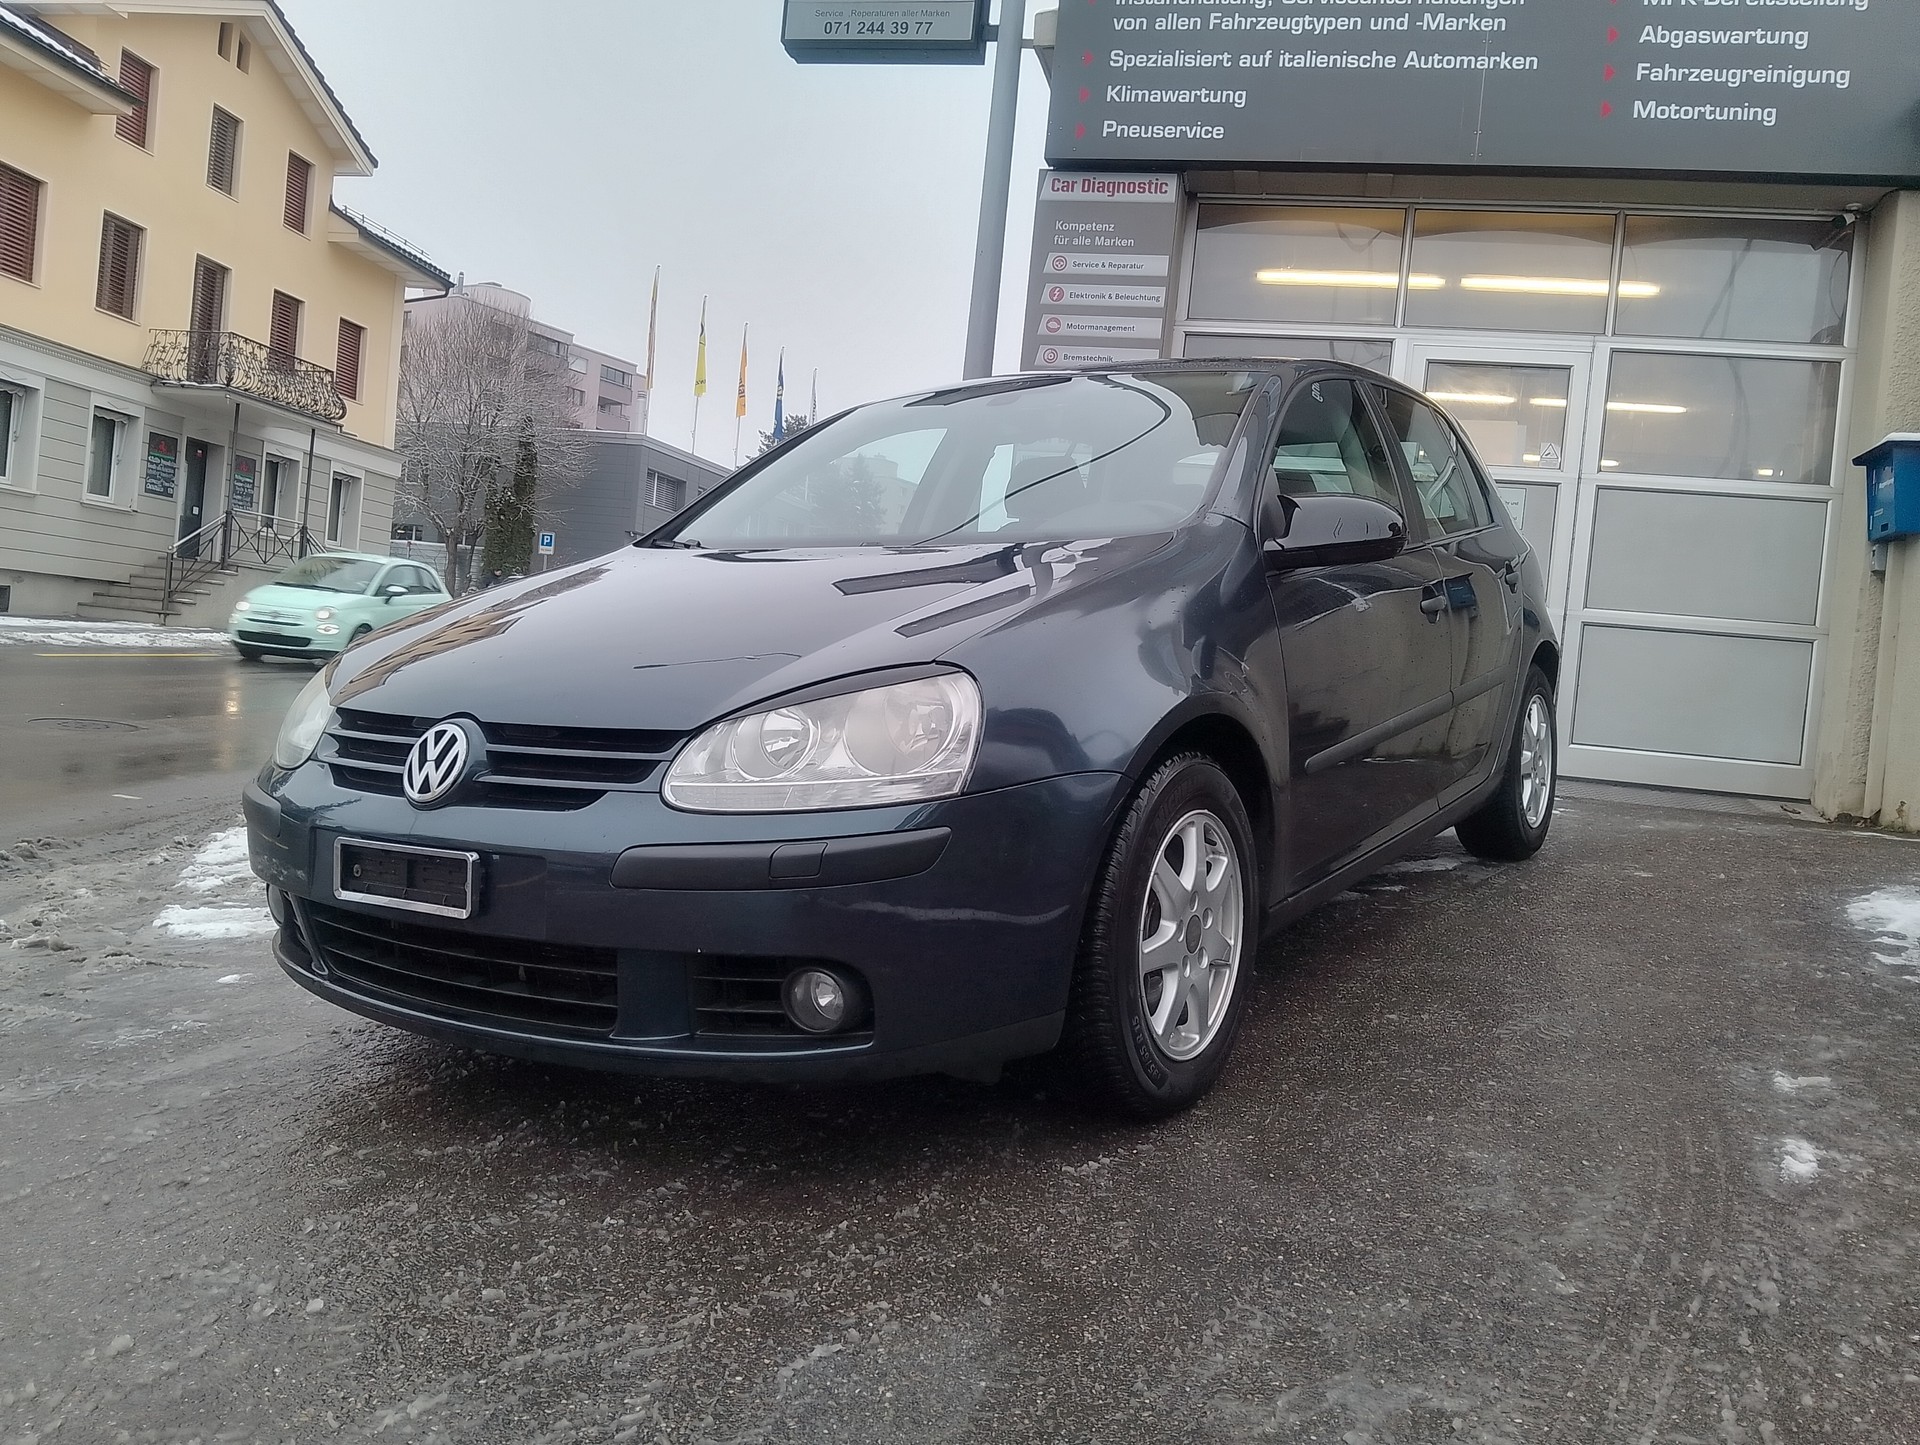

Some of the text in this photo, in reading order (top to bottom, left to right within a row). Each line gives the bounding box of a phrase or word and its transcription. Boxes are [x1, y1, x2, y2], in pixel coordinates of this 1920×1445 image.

[815, 9, 844, 18] Service
[901, 9, 919, 18] aller
[920, 9, 950, 18] Marken
[824, 21, 934, 35] 071 244 39 77
[1113, 13, 1507, 35] von allen Fahrzeugtypen und -Marken
[1638, 25, 1810, 50] Abgaswartung
[1109, 49, 1539, 71] Spezialisiert auf italienische Automarken
[1635, 62, 1851, 89] Fahrzeugreinigung
[1105, 84, 1247, 108] Klimawartung
[1632, 100, 1778, 127] Motortuning
[1101, 120, 1225, 140] Pneuservice
[1051, 176, 1169, 197] Car Diagnostic
[1055, 220, 1115, 233] Kompetenz
[1053, 235, 1135, 247] für alle Marken
[1072, 260, 1144, 271] Service & Reparatur
[1069, 291, 1106, 300] Elektronik
[1115, 292, 1161, 303] Beleuchtung
[1066, 322, 1136, 333] Motormanagement
[1063, 353, 1114, 363] Bremstechnik
[543, 535, 551, 546] P
